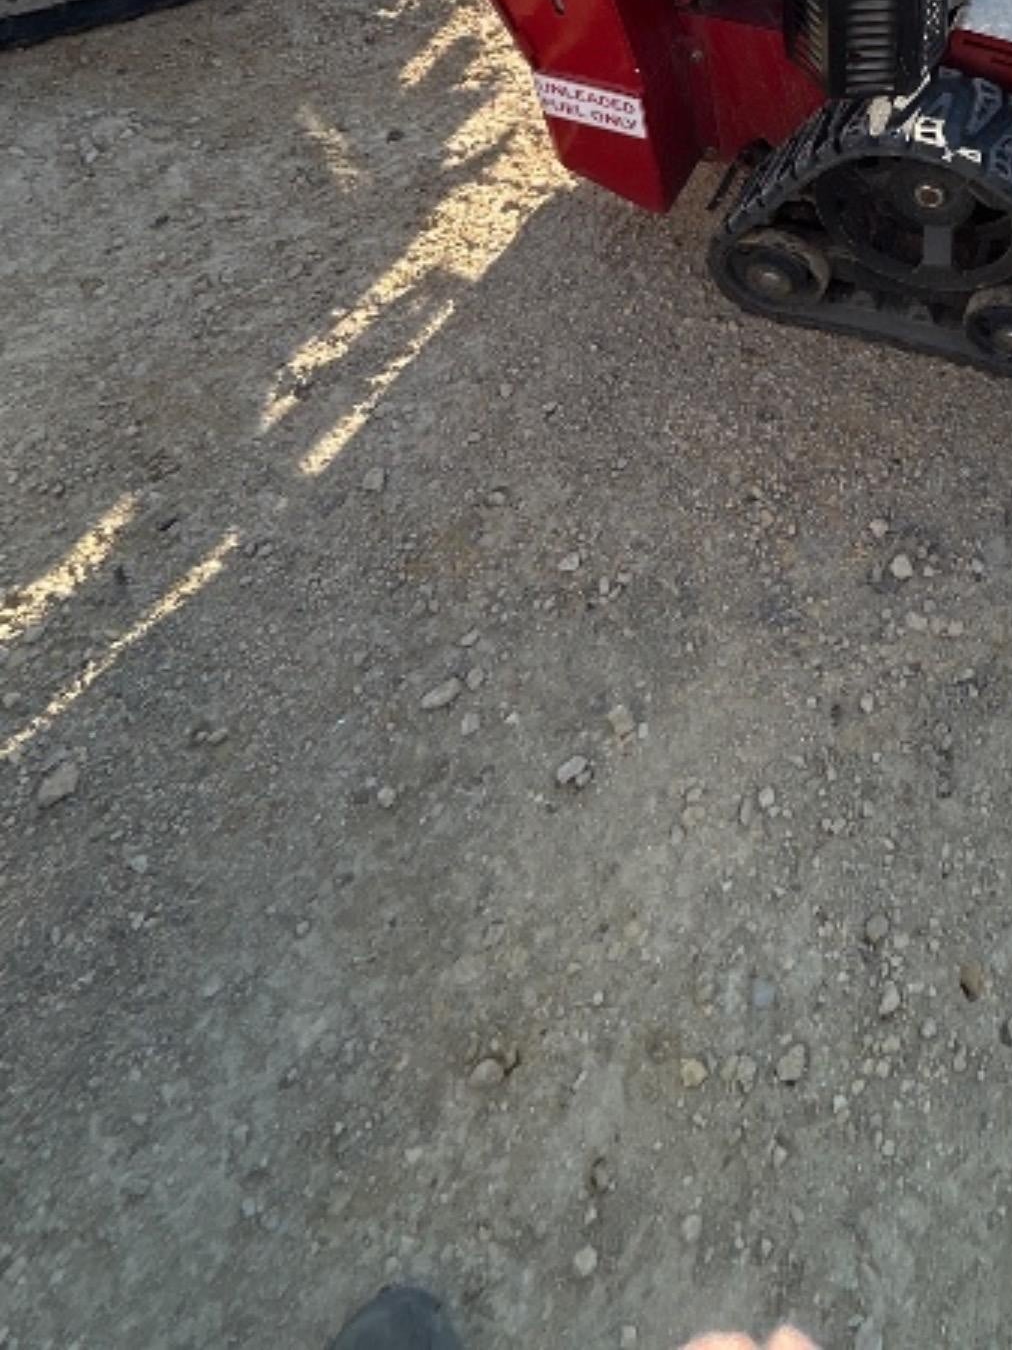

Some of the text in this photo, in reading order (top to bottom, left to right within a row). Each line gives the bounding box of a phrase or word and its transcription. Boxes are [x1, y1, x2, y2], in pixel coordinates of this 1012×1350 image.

[536, 79, 637, 114] UNLEADED
[541, 97, 638, 129] FUEL ONLY
